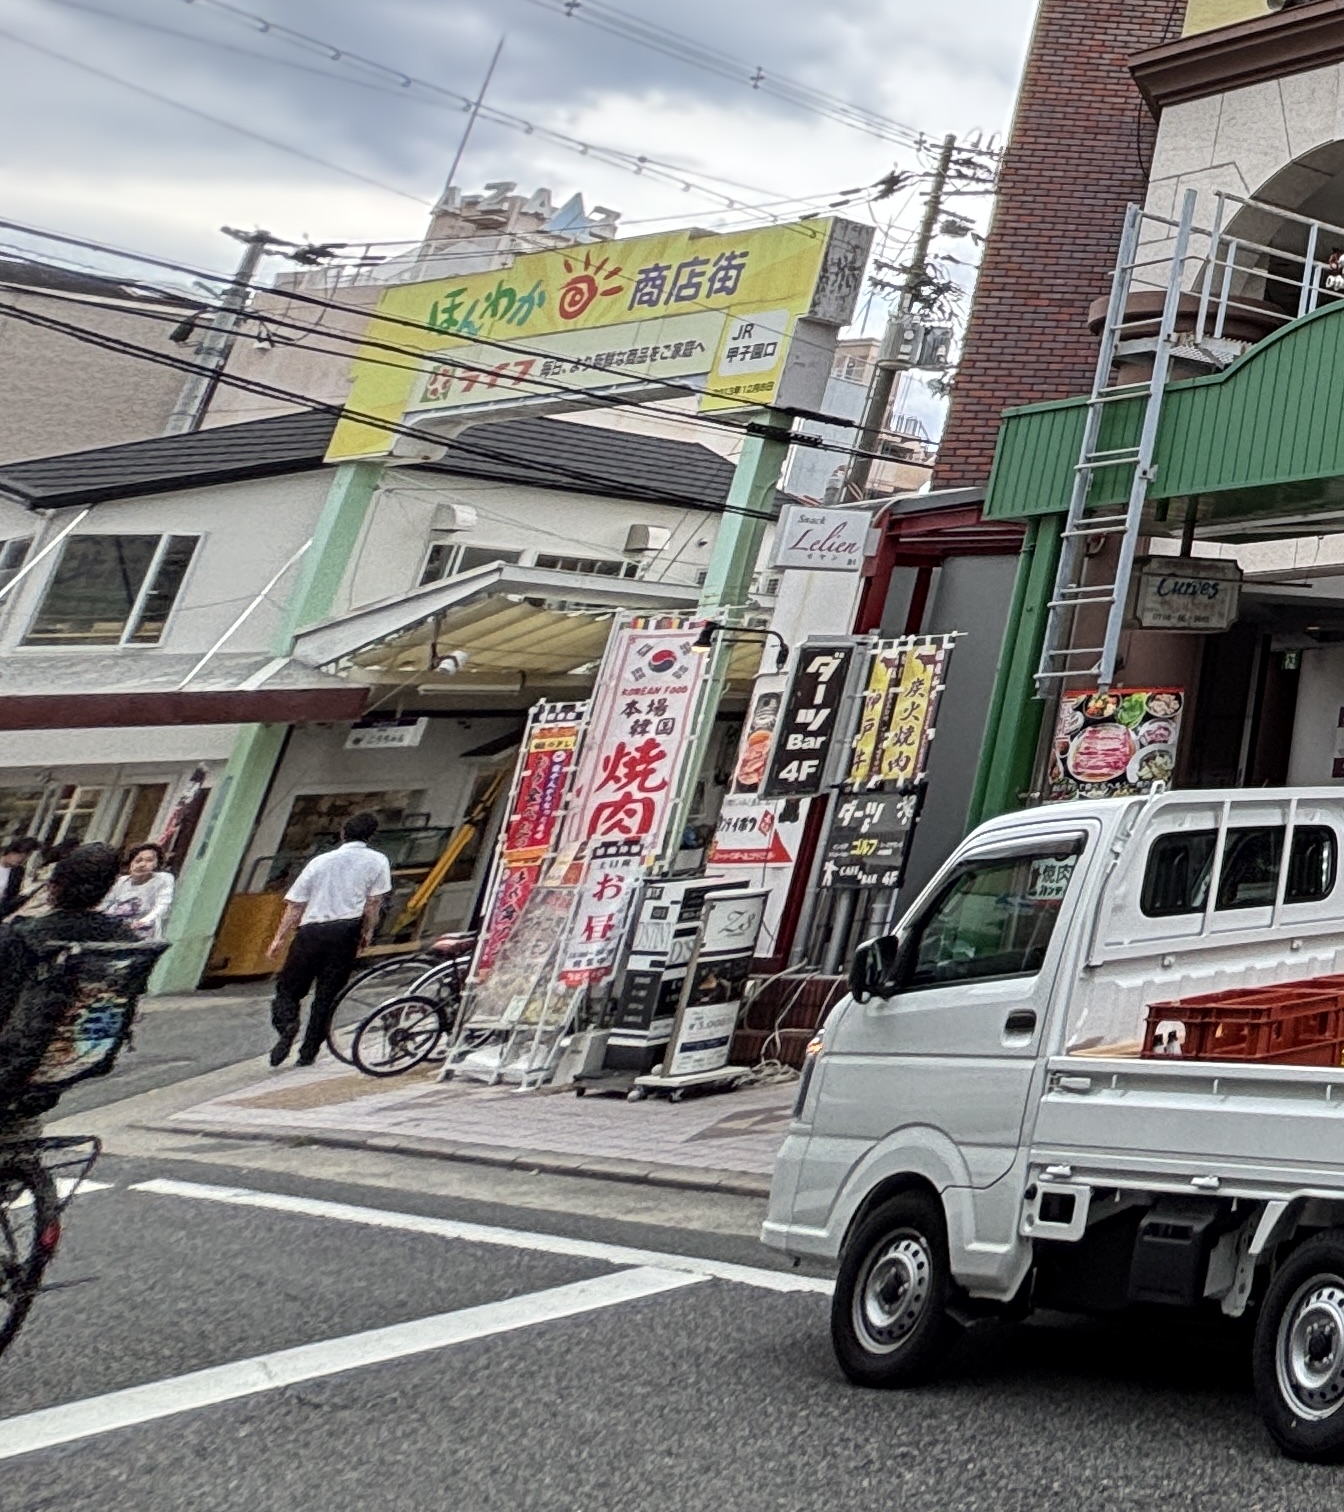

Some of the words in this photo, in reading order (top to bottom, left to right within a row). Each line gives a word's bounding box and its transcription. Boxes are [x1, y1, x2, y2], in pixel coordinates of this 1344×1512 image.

[429, 279, 547, 336] ほんわか
[627, 250, 750, 312] 商店街
[731, 322, 755, 341] JR
[726, 341, 778, 364] 甲子園口
[461, 359, 538, 393] ライフ
[1156, 573, 1220, 600] Curves
[795, 651, 845, 731] ダーツ
[620, 697, 670, 719] 本場
[628, 717, 676, 737] 韓国
[888, 676, 926, 774] 炭火焼肉
[785, 733, 827, 751] Bar
[778, 759, 820, 783] 4F
[587, 737, 669, 843] 焼肉
